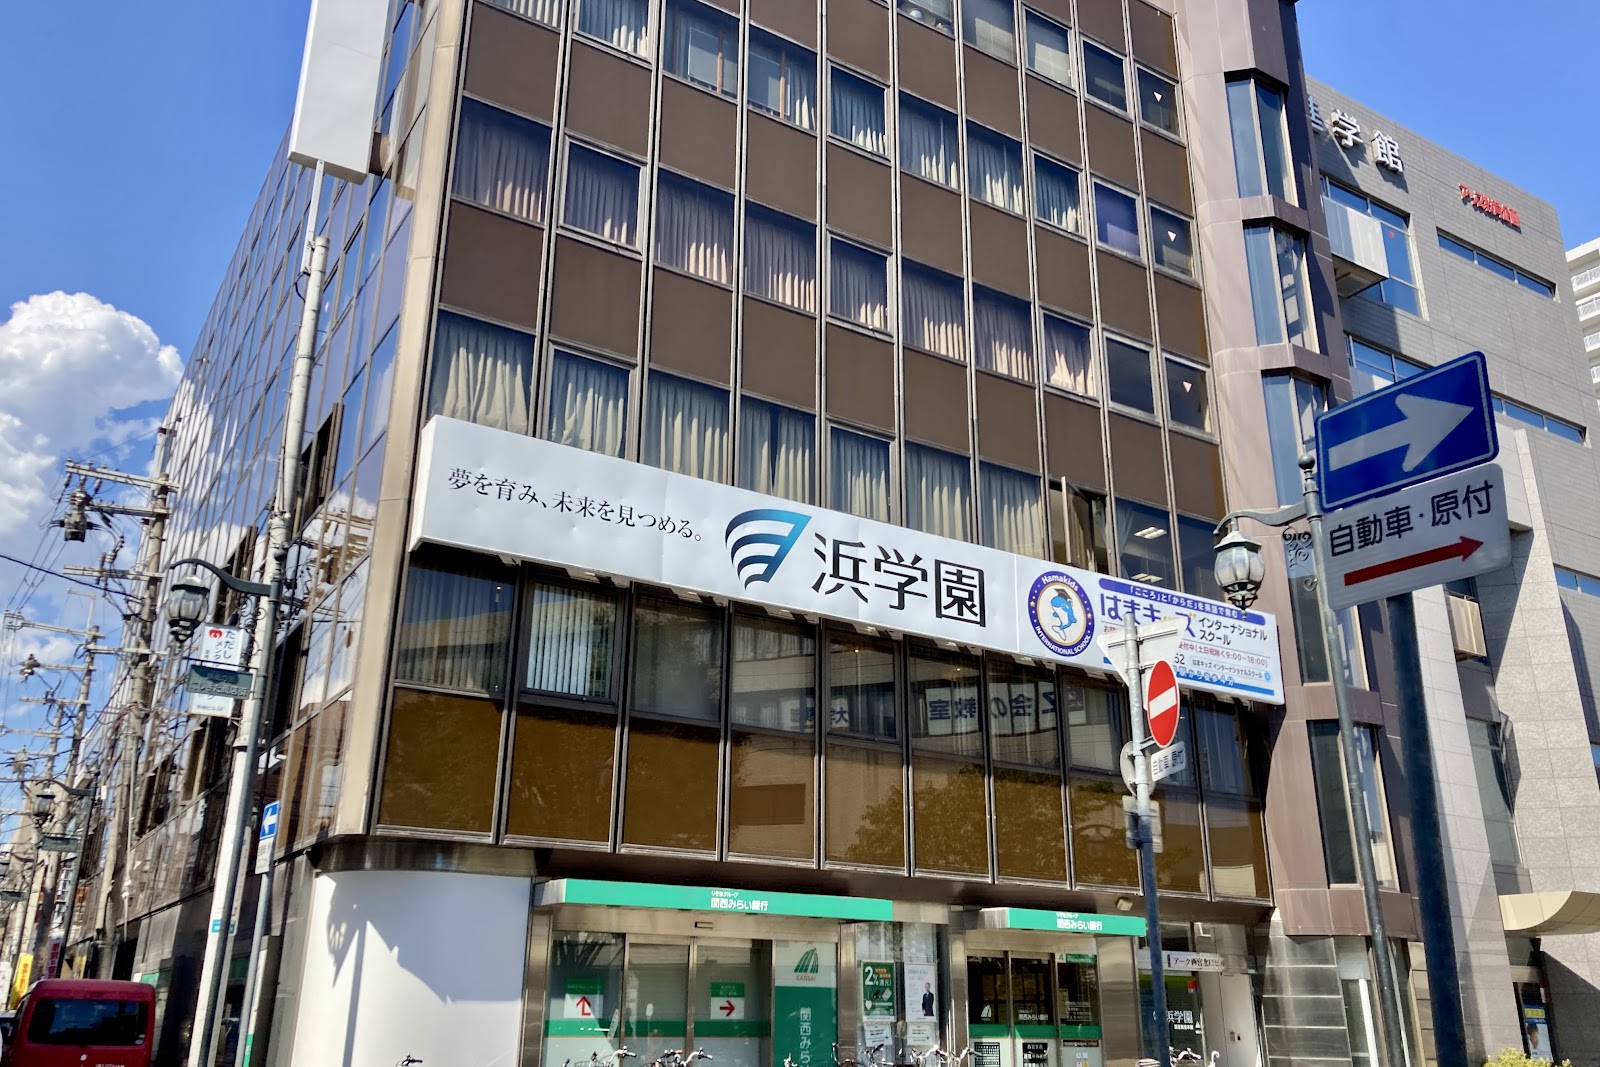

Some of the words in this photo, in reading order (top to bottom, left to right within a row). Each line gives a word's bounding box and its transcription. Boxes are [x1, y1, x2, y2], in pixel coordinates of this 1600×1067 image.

[448, 467, 703, 542] 夢を育み、未来を見つめる。
[1329, 480, 1493, 557] 自動車・原付
[811, 531, 986, 628] 浜学園
[1041, 575, 1079, 592] Hamakids
[1035, 625, 1074, 656] INTERNATIONAL
[1073, 634, 1092, 655] SCHOOL
[1198, 616, 1268, 642] インターナショナル
[1199, 628, 1232, 646] スクール
[710, 897, 769, 911] 関西みらい銀行
[800, 1007, 812, 1067] 関西みら
